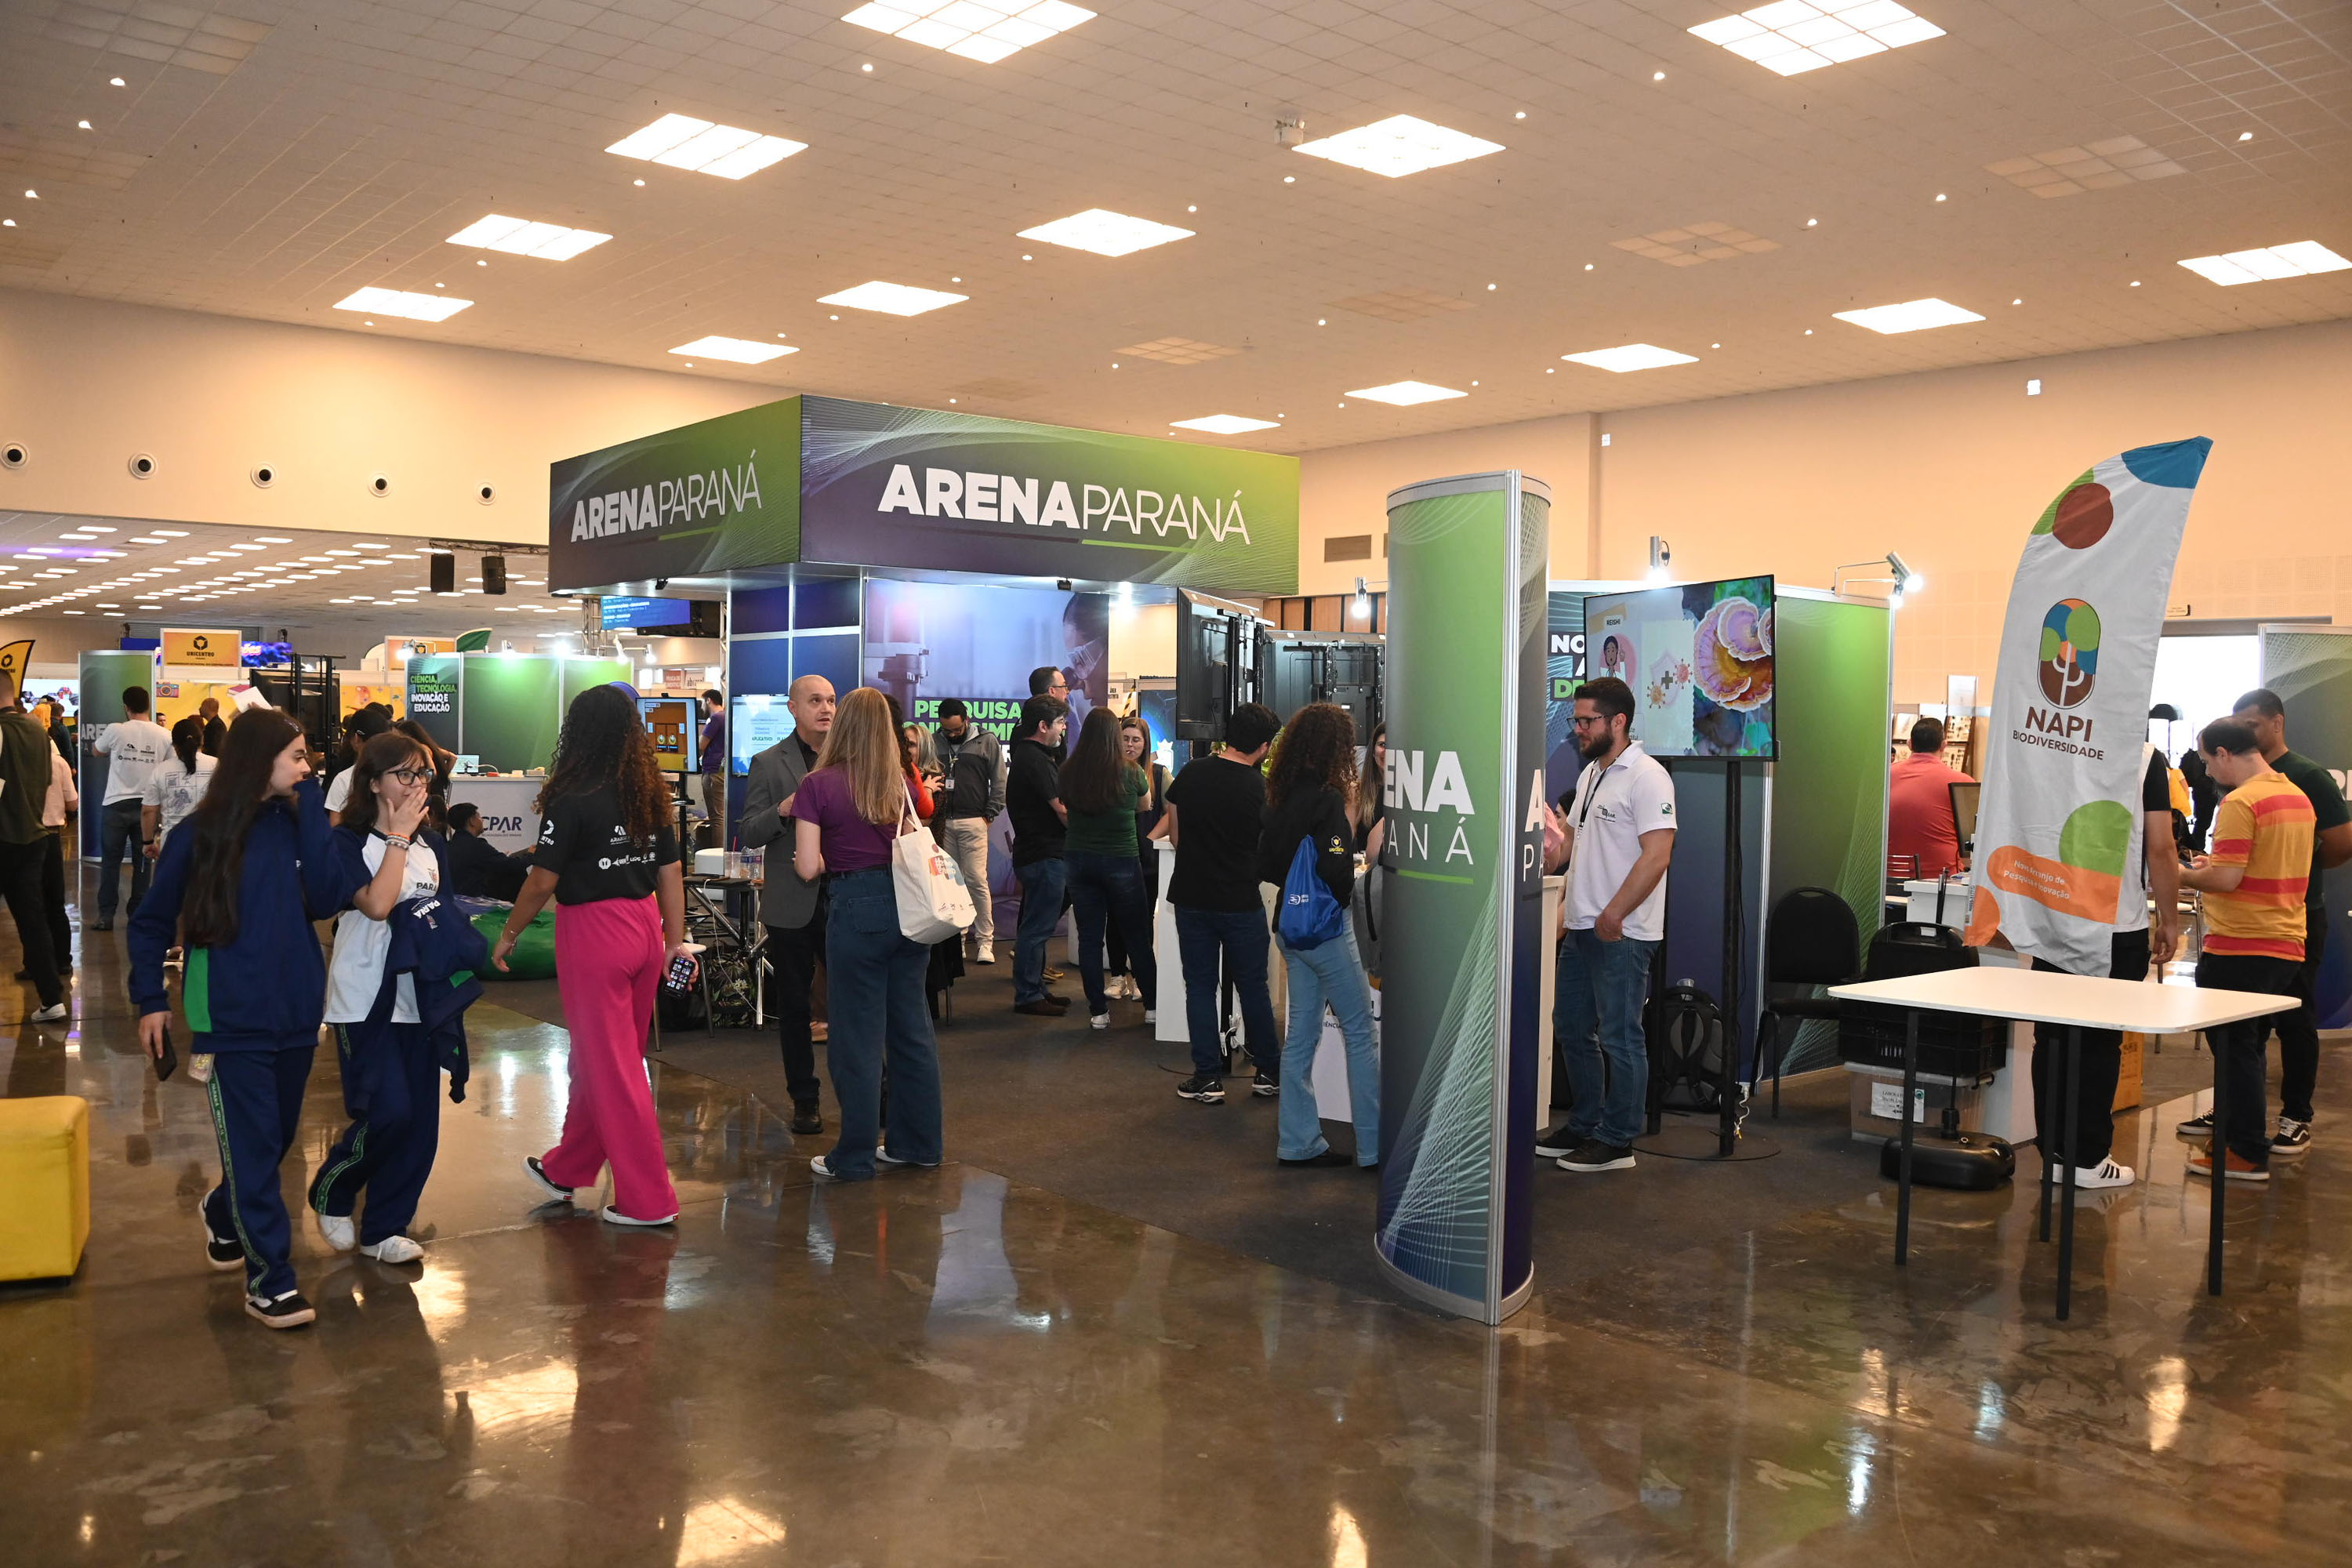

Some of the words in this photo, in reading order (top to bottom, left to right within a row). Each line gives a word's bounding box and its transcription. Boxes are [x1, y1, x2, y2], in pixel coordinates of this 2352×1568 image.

[410, 673, 437, 684] CIÊNCIA,
[417, 684, 457, 693] TECNOLOGIA,
[411, 691, 443, 703] INOVAÇÃO
[444, 693, 448, 702] E
[414, 702, 450, 713] EDUCAÇÃO
[914, 700, 1022, 720] PEQUISA
[2025, 706, 2093, 742] NAPI
[81, 724, 108, 740] ARE
[2013, 730, 2105, 760] BIODIVERSIDADE
[1387, 816, 1474, 866] ANÁ
[2055, 877, 2065, 885] de
